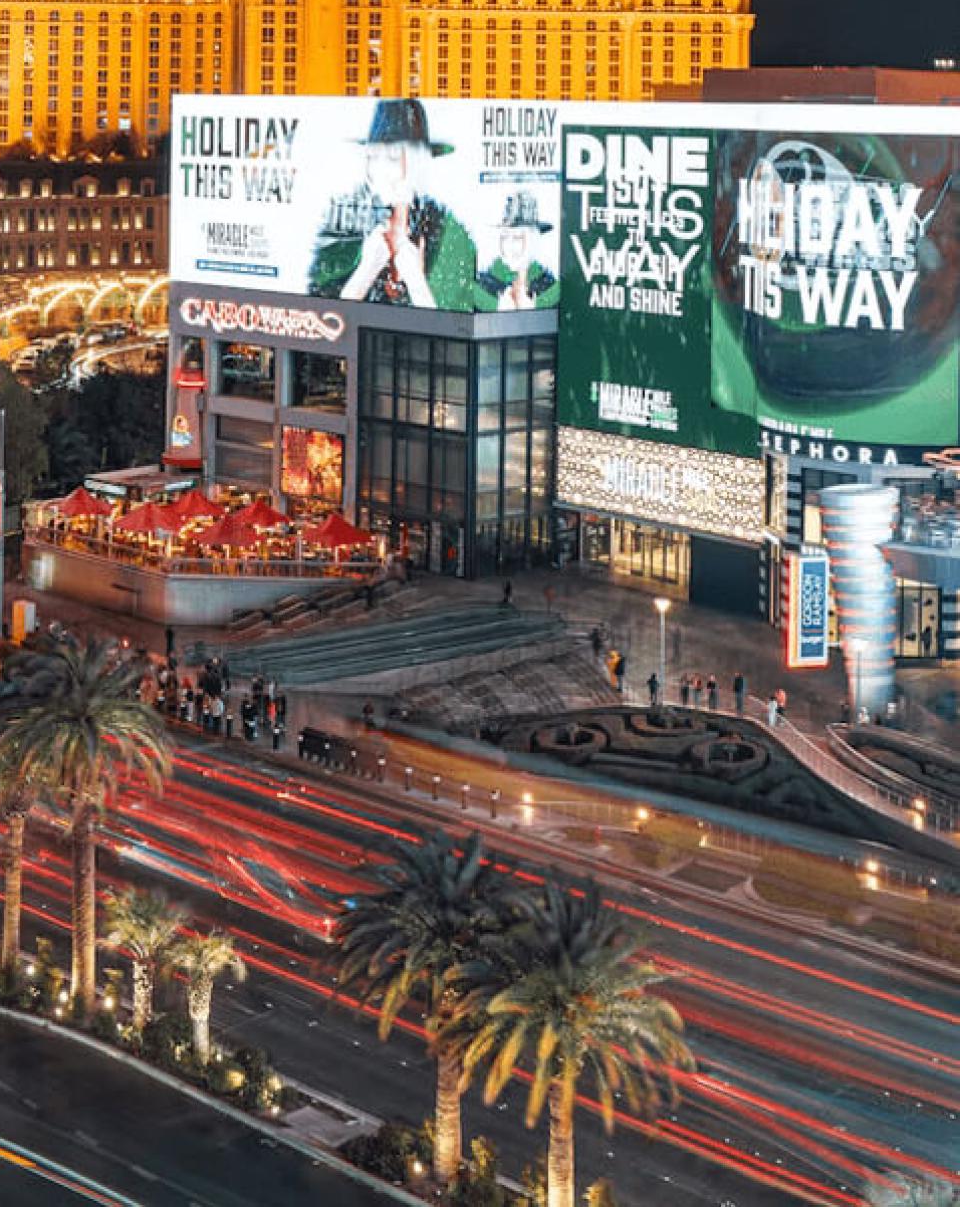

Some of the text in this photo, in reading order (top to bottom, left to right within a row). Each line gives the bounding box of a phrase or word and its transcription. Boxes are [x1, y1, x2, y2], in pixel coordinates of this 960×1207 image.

[181, 116, 299, 160] HOLIDAY
[483, 107, 557, 138] HOLIDAY
[483, 142, 557, 167] THIS WAY
[566, 133, 709, 187] DINE
[180, 162, 297, 204] THIS WAY
[590, 283, 683, 317] AND SHINE
[796, 264, 918, 330] WAY
[757, 430, 899, 466] SEPHORA
